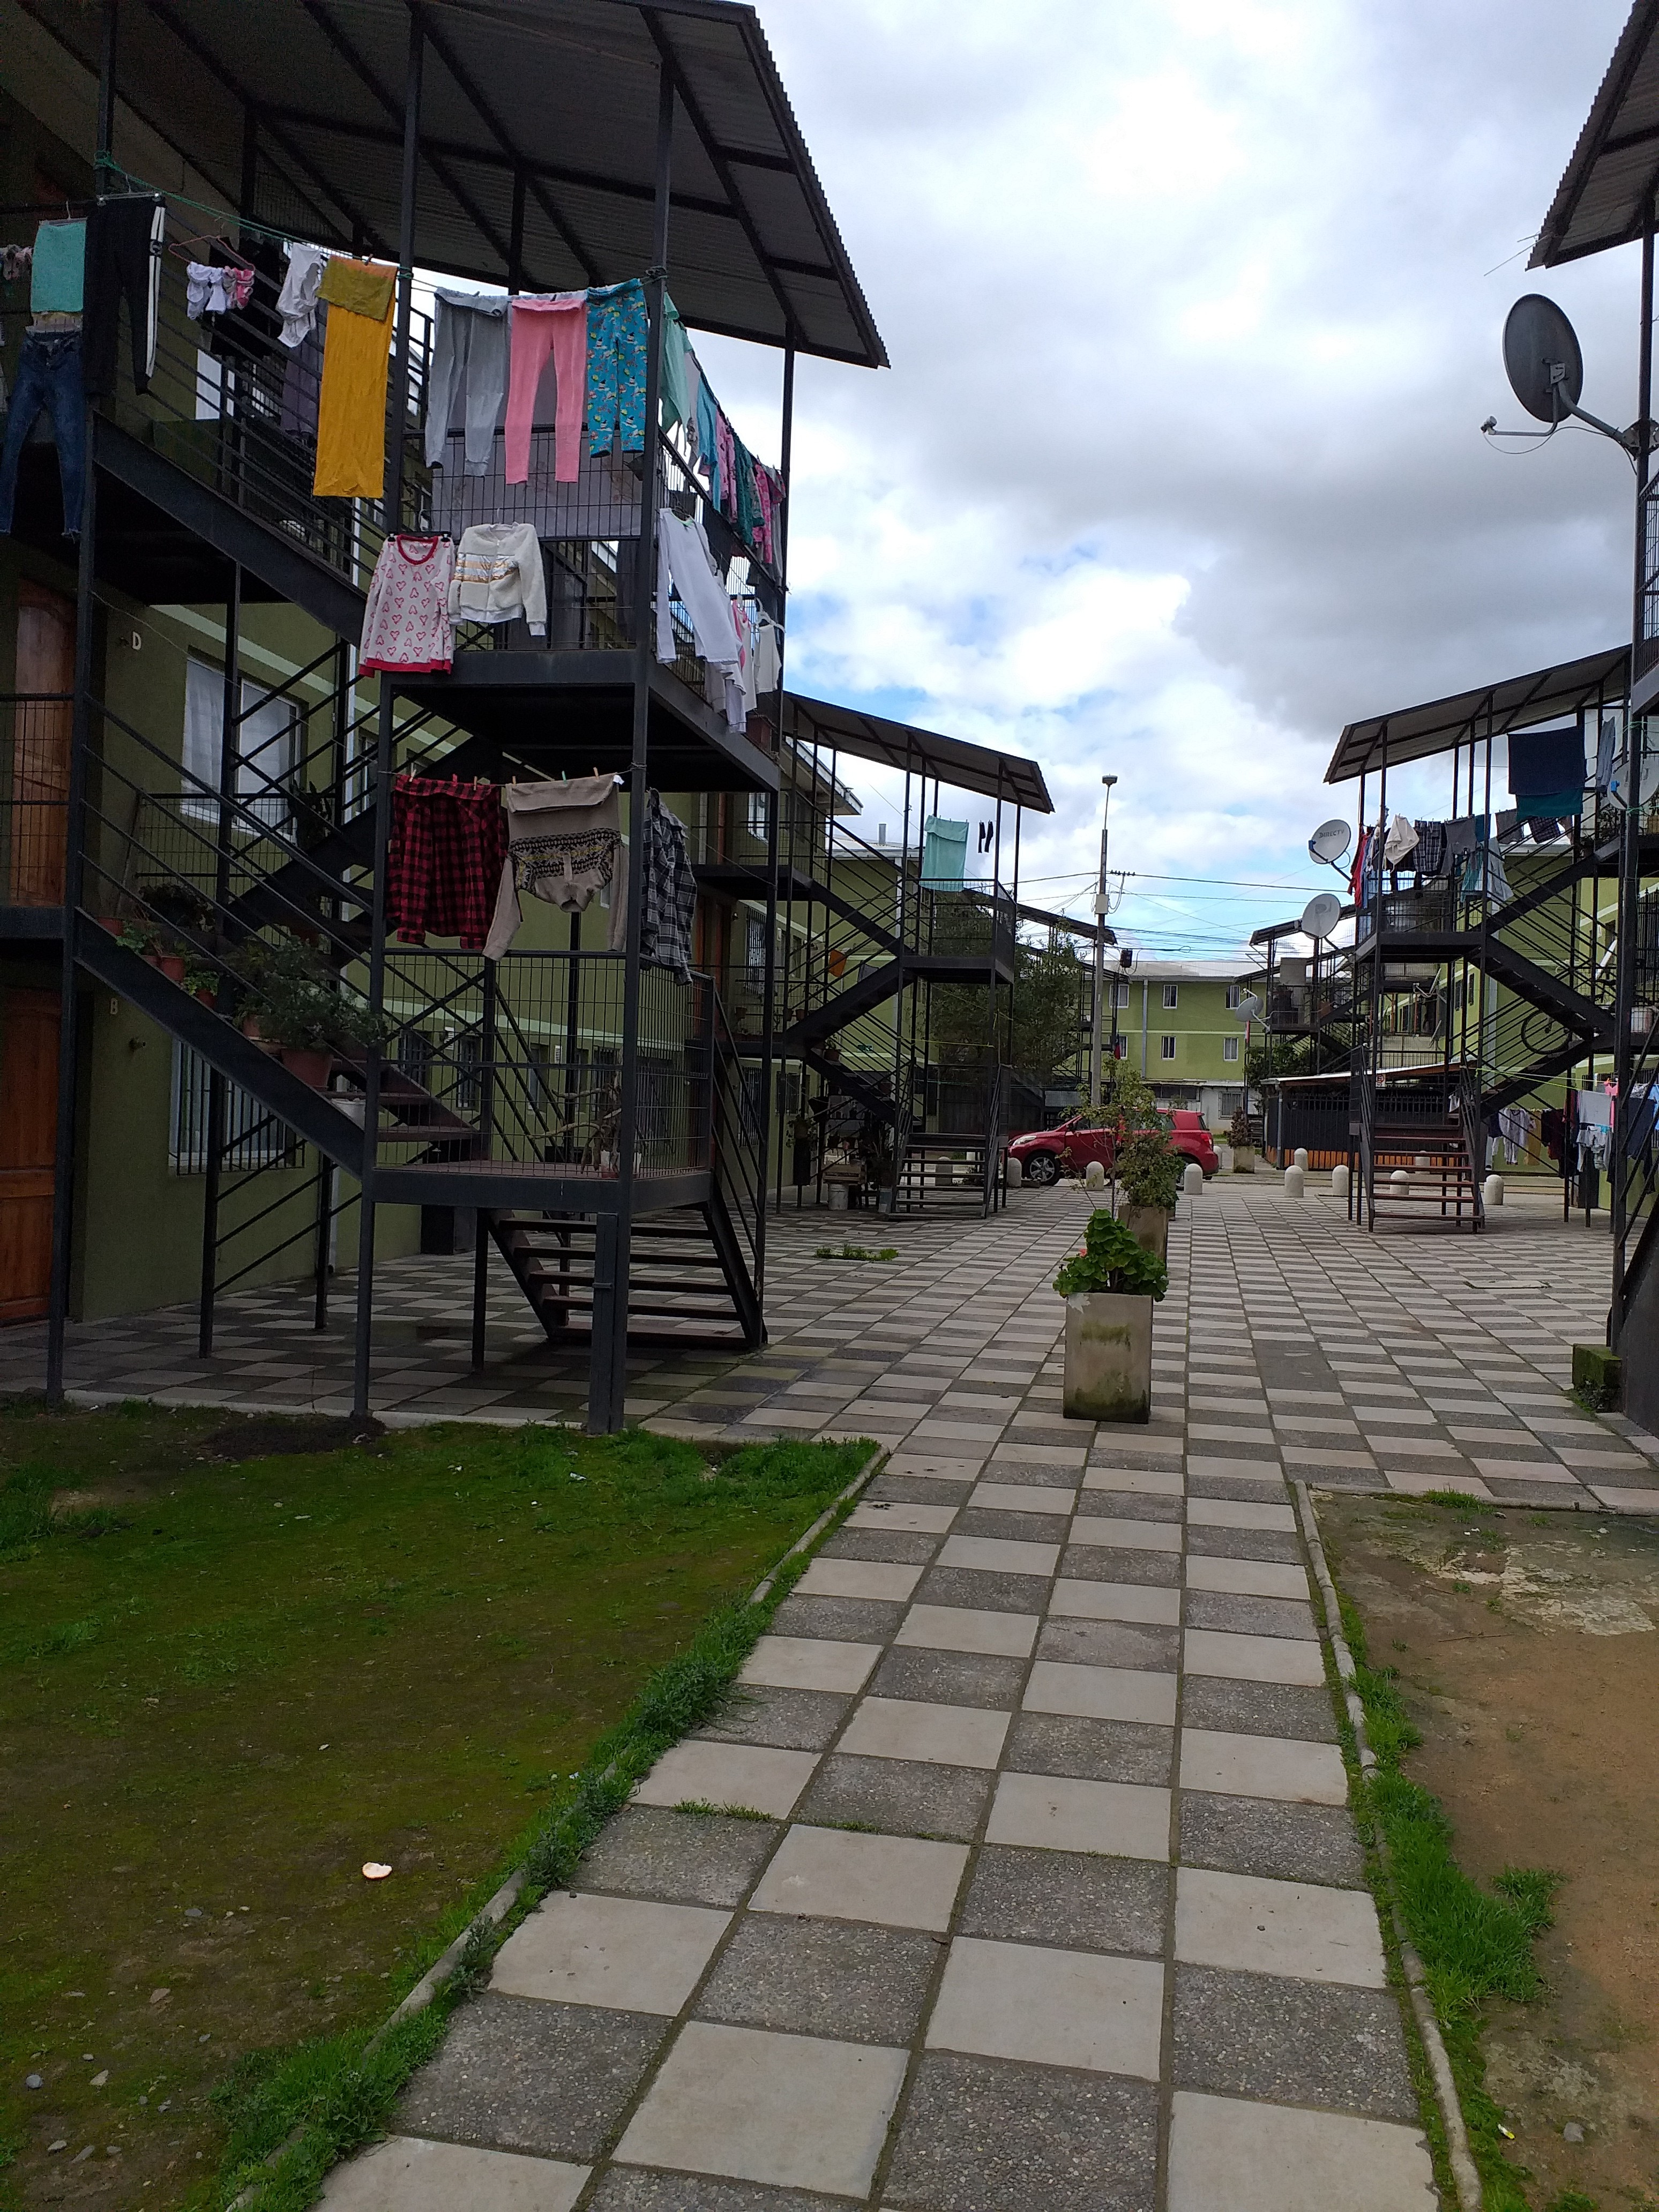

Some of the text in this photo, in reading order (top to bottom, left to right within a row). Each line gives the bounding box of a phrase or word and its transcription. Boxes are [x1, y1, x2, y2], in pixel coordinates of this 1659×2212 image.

[132, 631, 141, 649] D
[1319, 829, 1344, 839] DIRECTV
[110, 998, 118, 1014] B
